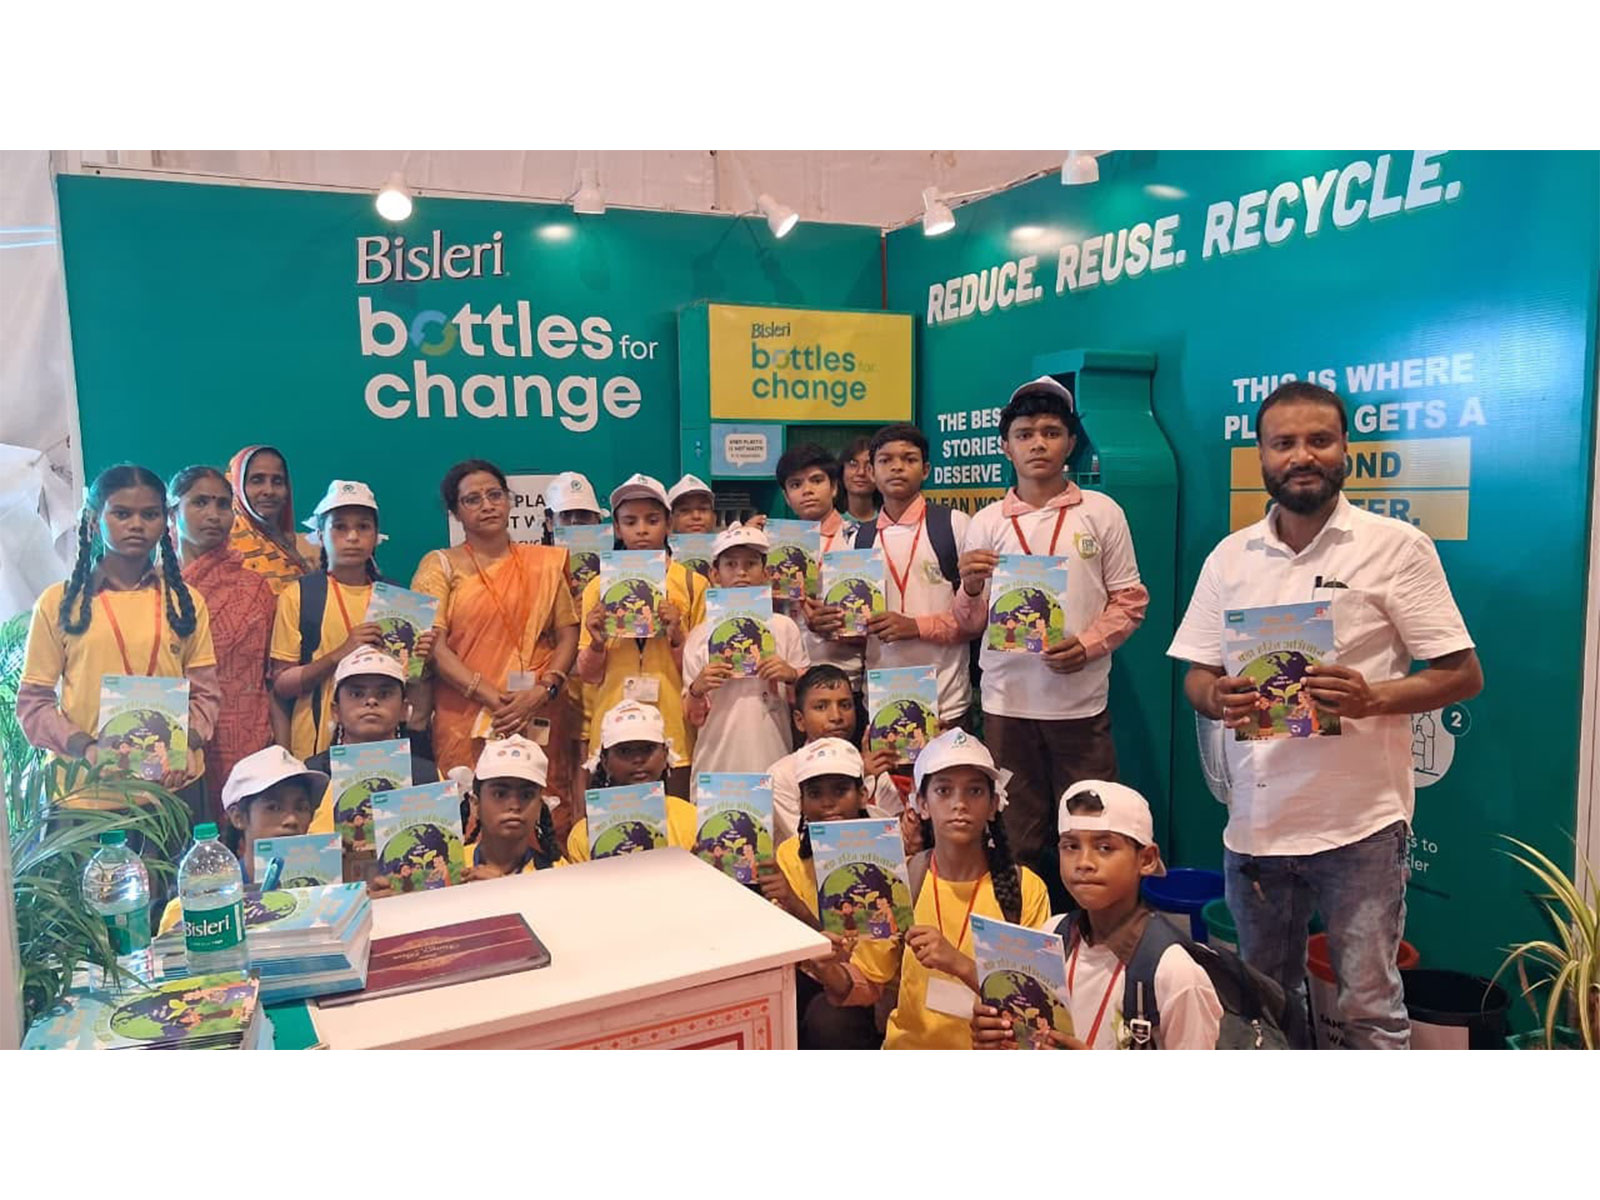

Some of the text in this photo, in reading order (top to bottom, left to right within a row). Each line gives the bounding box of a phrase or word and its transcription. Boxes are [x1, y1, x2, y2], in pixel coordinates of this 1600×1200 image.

[927, 150, 1461, 325] REDUCE. REUSE. RECYCLE.
[356, 229, 504, 284] Bisleri
[358, 296, 658, 359] bottles for
[751, 321, 791, 339] Bisleri
[751, 342, 856, 373] bottles
[1346, 353, 1474, 393] WHERE
[364, 359, 642, 432] change
[752, 372, 867, 408] change
[938, 408, 1001, 432] THE BES
[1354, 397, 1487, 433] GETS A
[934, 464, 1002, 484] DESERVE
[1451, 712, 1462, 728] 2
[1421, 838, 1438, 853] to
[184, 914, 230, 937] Bisleri
